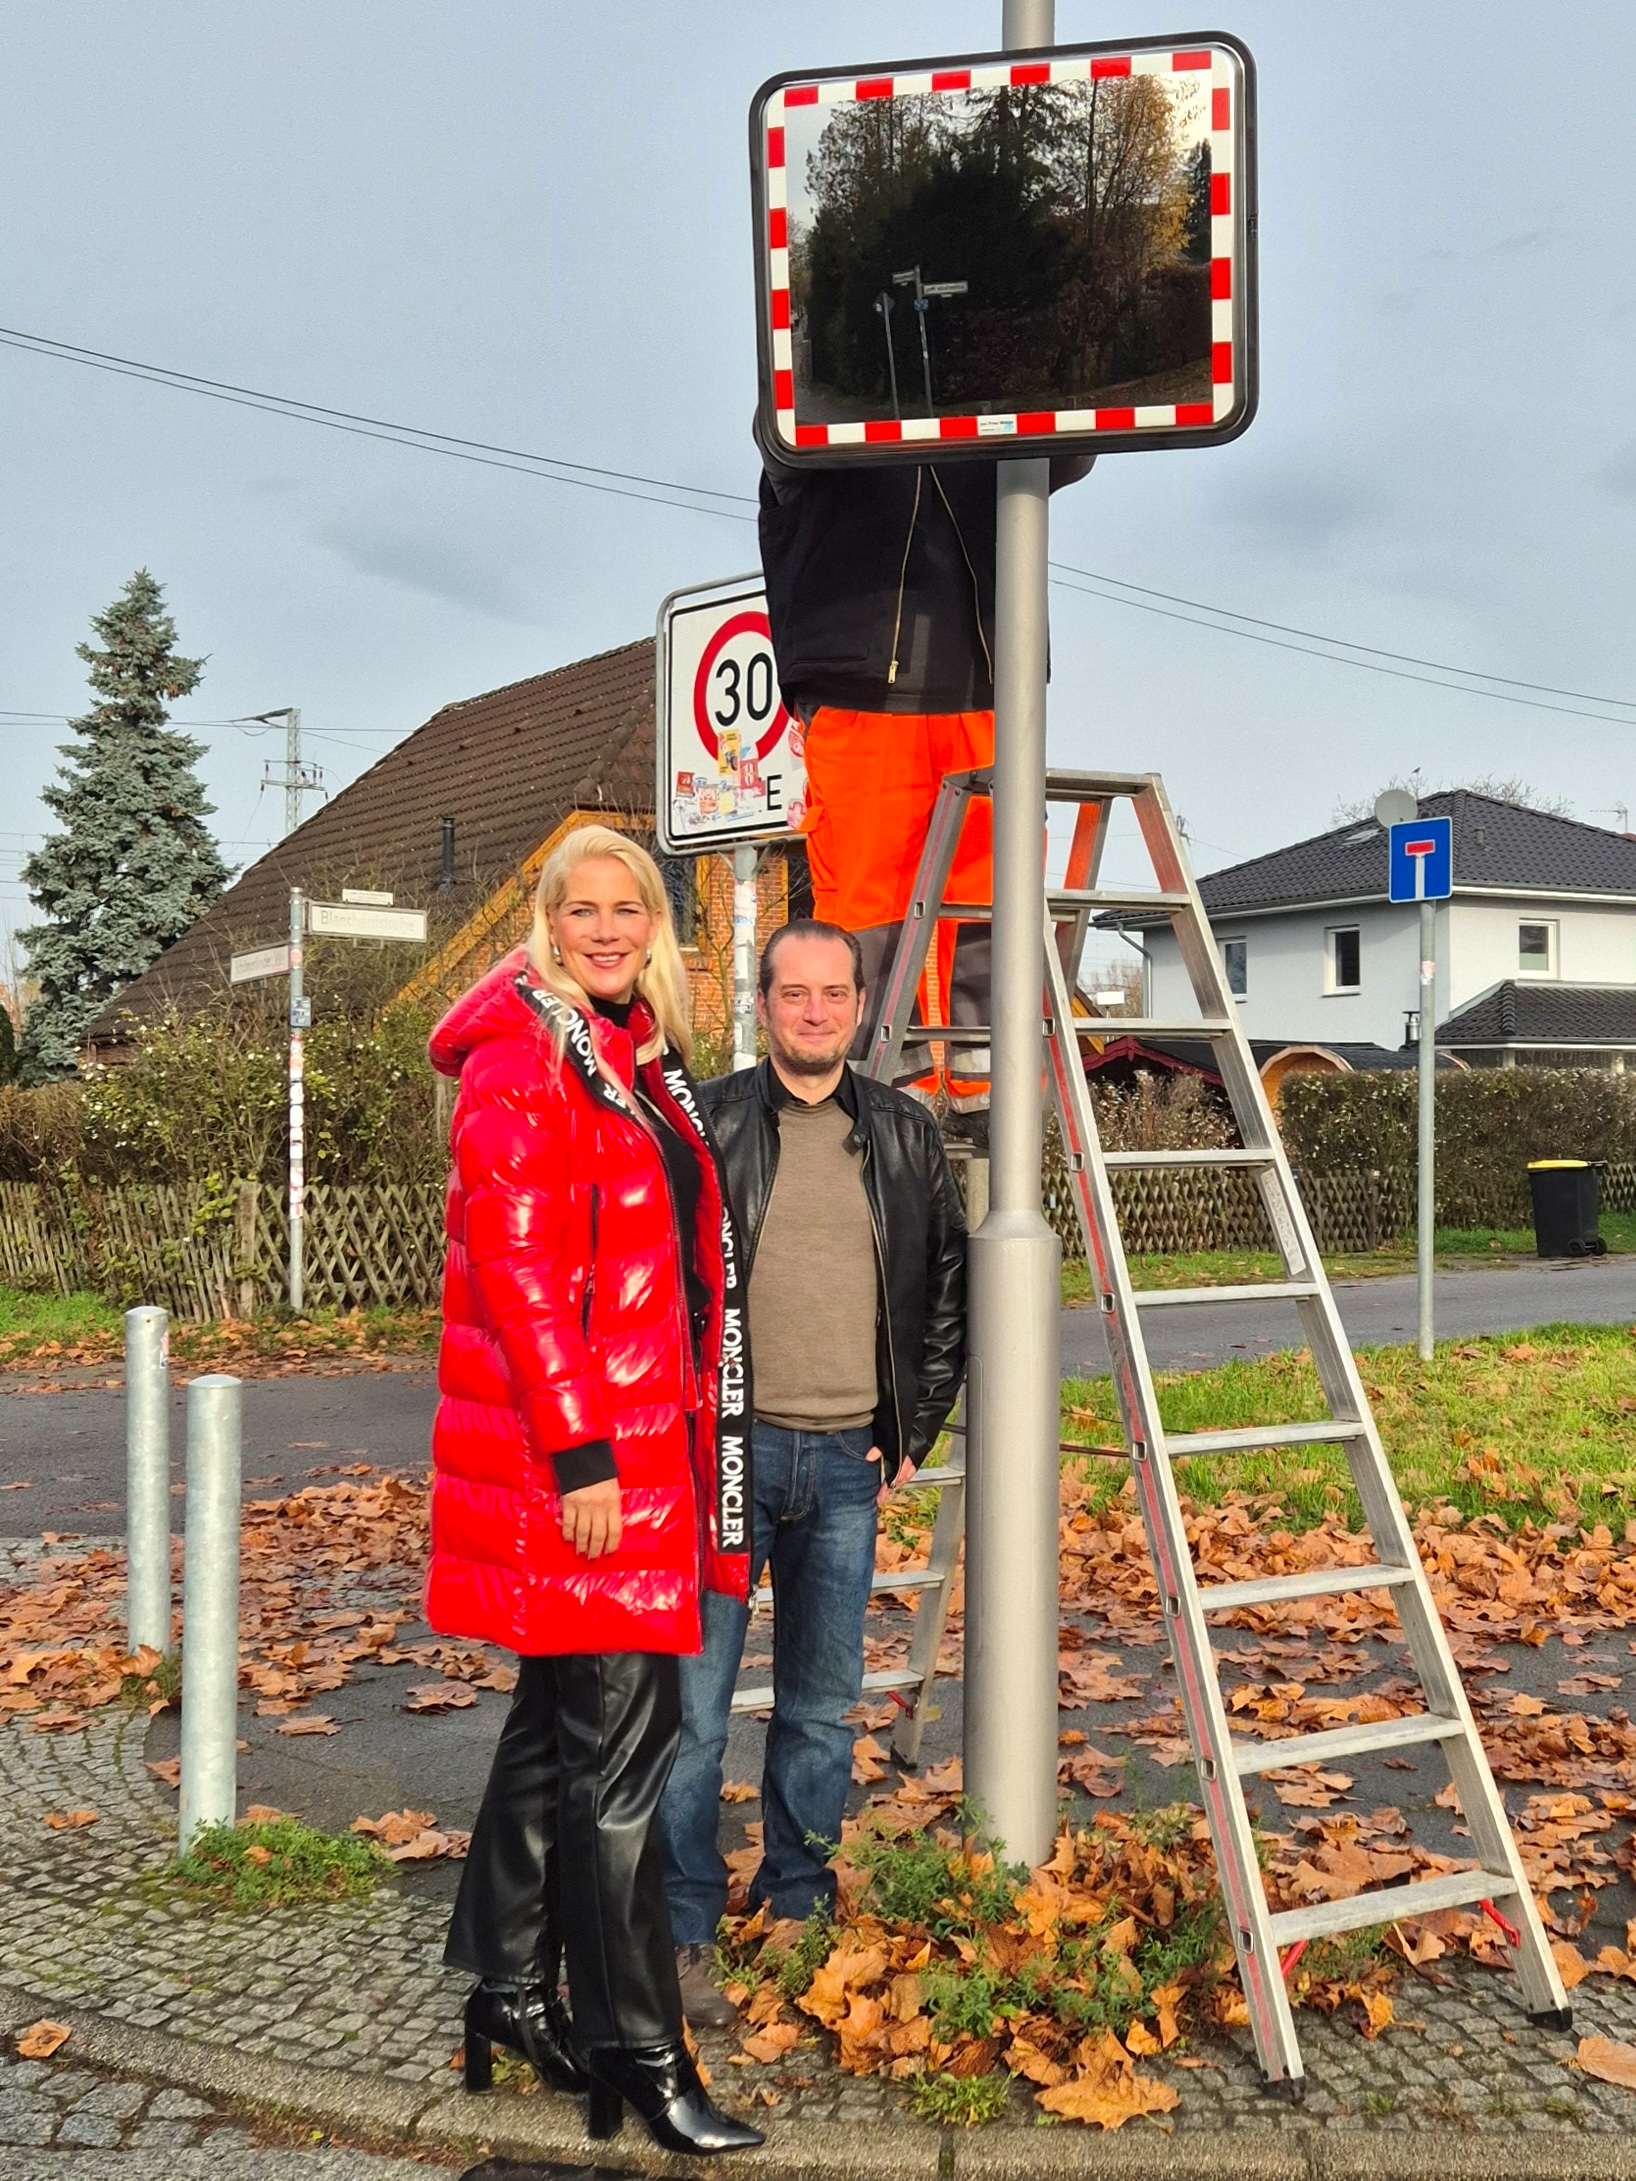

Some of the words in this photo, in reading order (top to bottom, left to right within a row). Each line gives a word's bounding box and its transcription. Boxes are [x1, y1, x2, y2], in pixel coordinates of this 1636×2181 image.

[714, 651, 773, 727] 30
[721, 1308, 744, 1419] MONCLER
[721, 1435, 744, 1549] MONCLER
